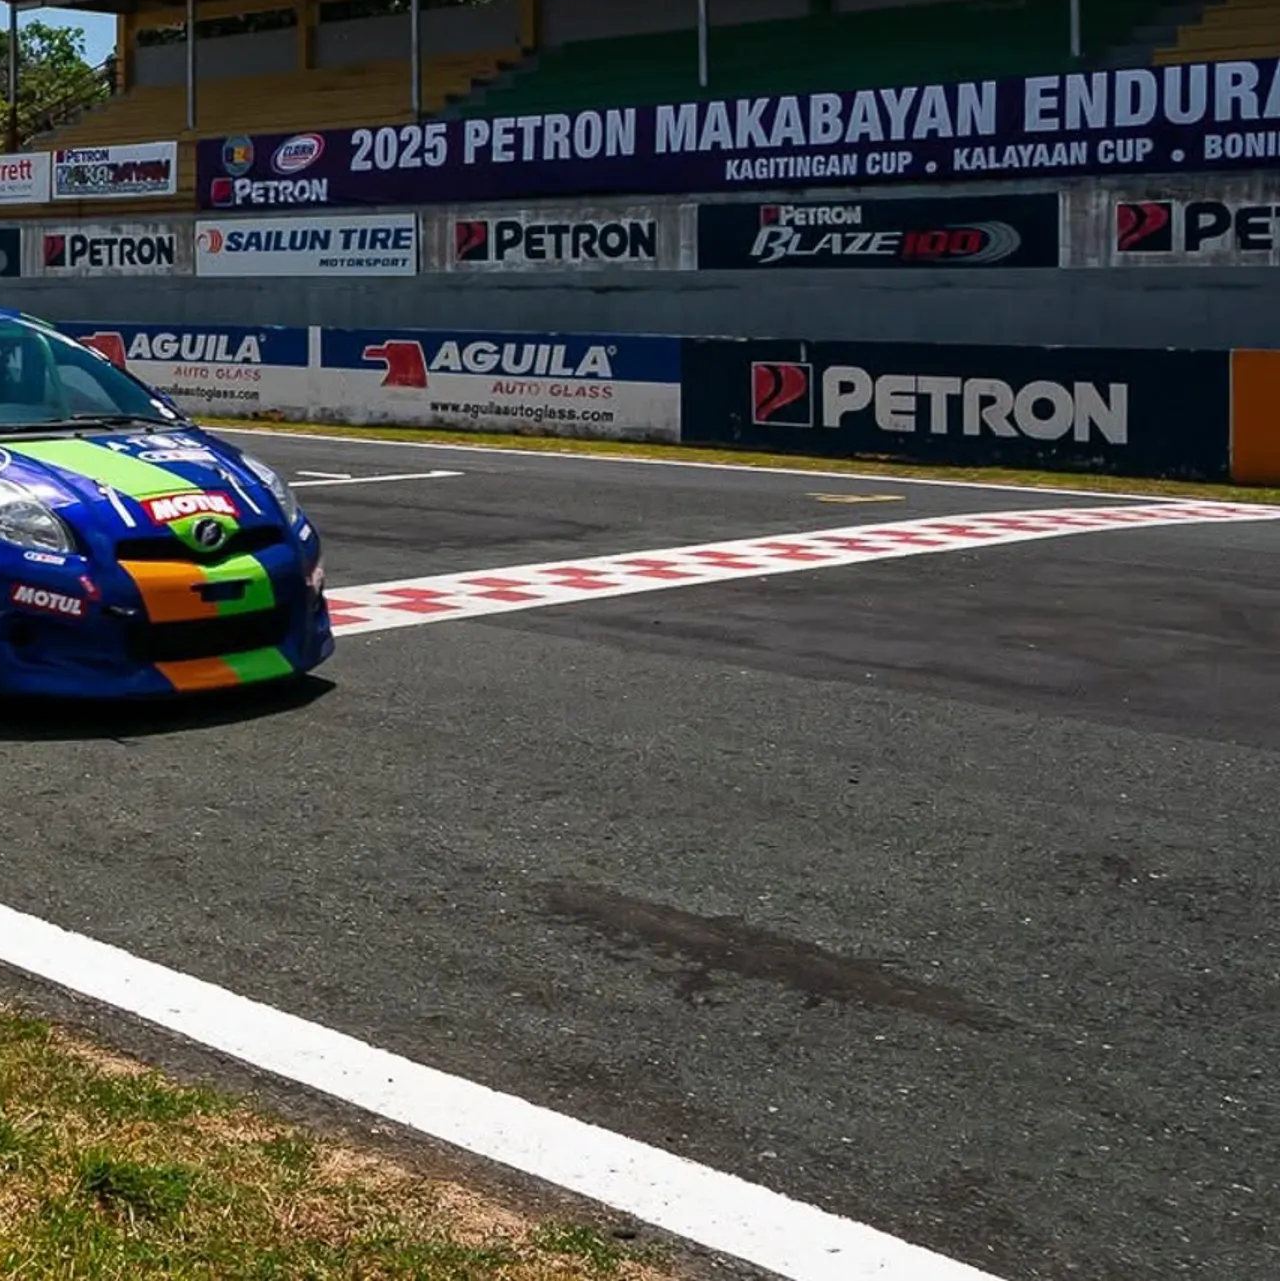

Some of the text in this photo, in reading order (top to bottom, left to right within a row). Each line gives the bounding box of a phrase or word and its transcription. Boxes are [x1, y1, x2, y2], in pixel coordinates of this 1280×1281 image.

[350, 122, 447, 171] 2025
[464, 108, 637, 164] PETRON
[655, 81, 997, 154] MAKABAYAN
[725, 154, 858, 180] KAGITINGAN
[866, 151, 913, 175] CUP
[953, 141, 1088, 171] KALAYAAN
[1097, 137, 1154, 164] CUP
[234, 178, 328, 205] PETRON
[779, 205, 861, 225] PETRON
[70, 234, 174, 266] PETRON
[225, 227, 414, 252] SAILUN TIRE
[495, 220, 657, 261] PETRON
[319, 257, 409, 268] MOTORSPORT
[127, 332, 262, 363] AGUILA
[429, 340, 613, 378] AGUILA
[174, 366, 262, 382] AUTO GLASS
[493, 381, 614, 399] AUTO GLASS
[430, 401, 614, 422] www.aguilaautoglass.com
[822, 365, 1128, 444] PETRON
[150, 494, 237, 521] MOTUL
[14, 586, 82, 615] MOTUL
